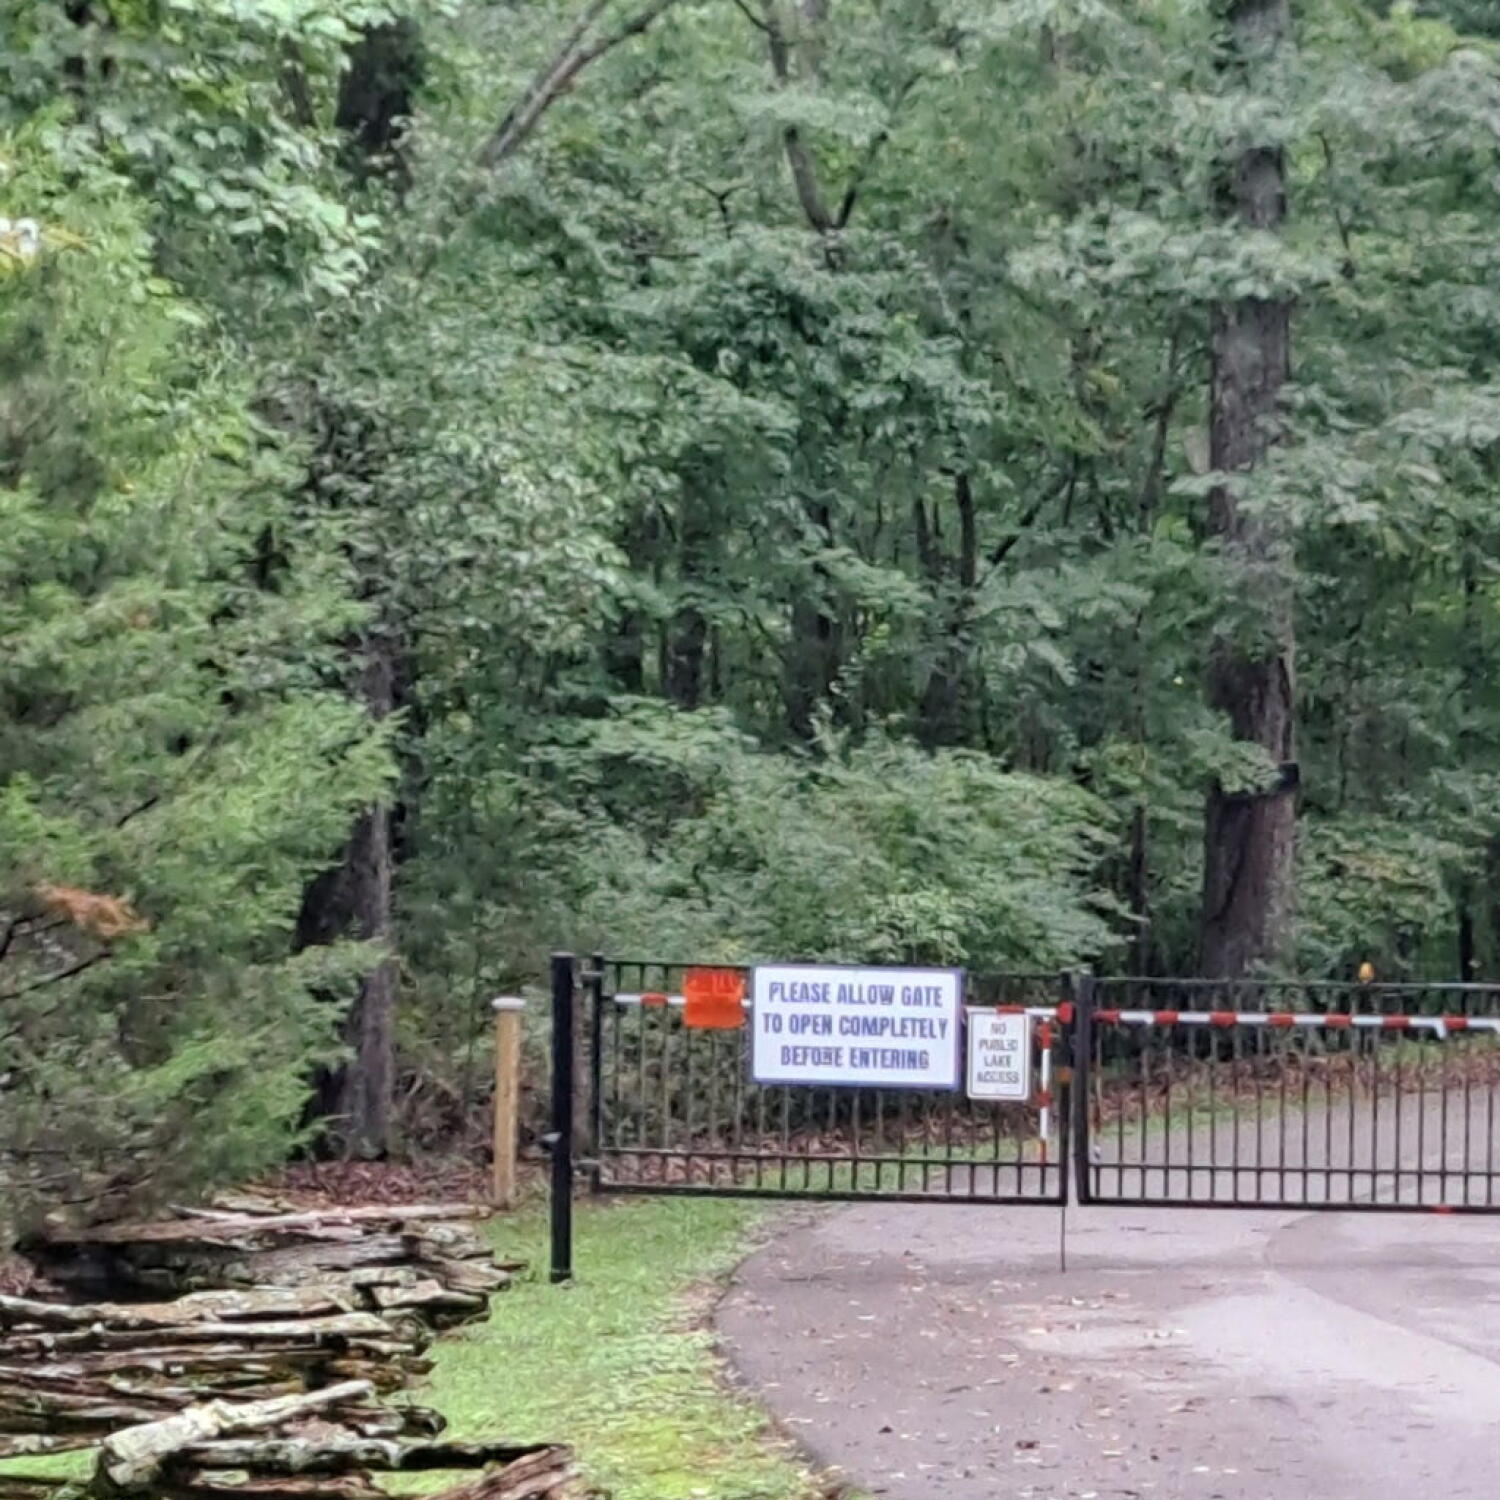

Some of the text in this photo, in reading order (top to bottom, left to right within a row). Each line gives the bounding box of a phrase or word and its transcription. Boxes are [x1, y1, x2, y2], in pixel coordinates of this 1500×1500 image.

[768, 982, 831, 1004] PLEASE
[837, 983, 895, 1006] ALLOW
[901, 985, 942, 1008] GATE
[762, 1012, 949, 1040] TO OPEN COMPLETELY
[991, 1022, 1007, 1035] NO
[979, 1038, 1019, 1051] PUBLIC
[780, 1045, 930, 1070] BEFORE ENTERING
[984, 1054, 1012, 1067] LAKE
[976, 1071, 1021, 1084] ACCESS
